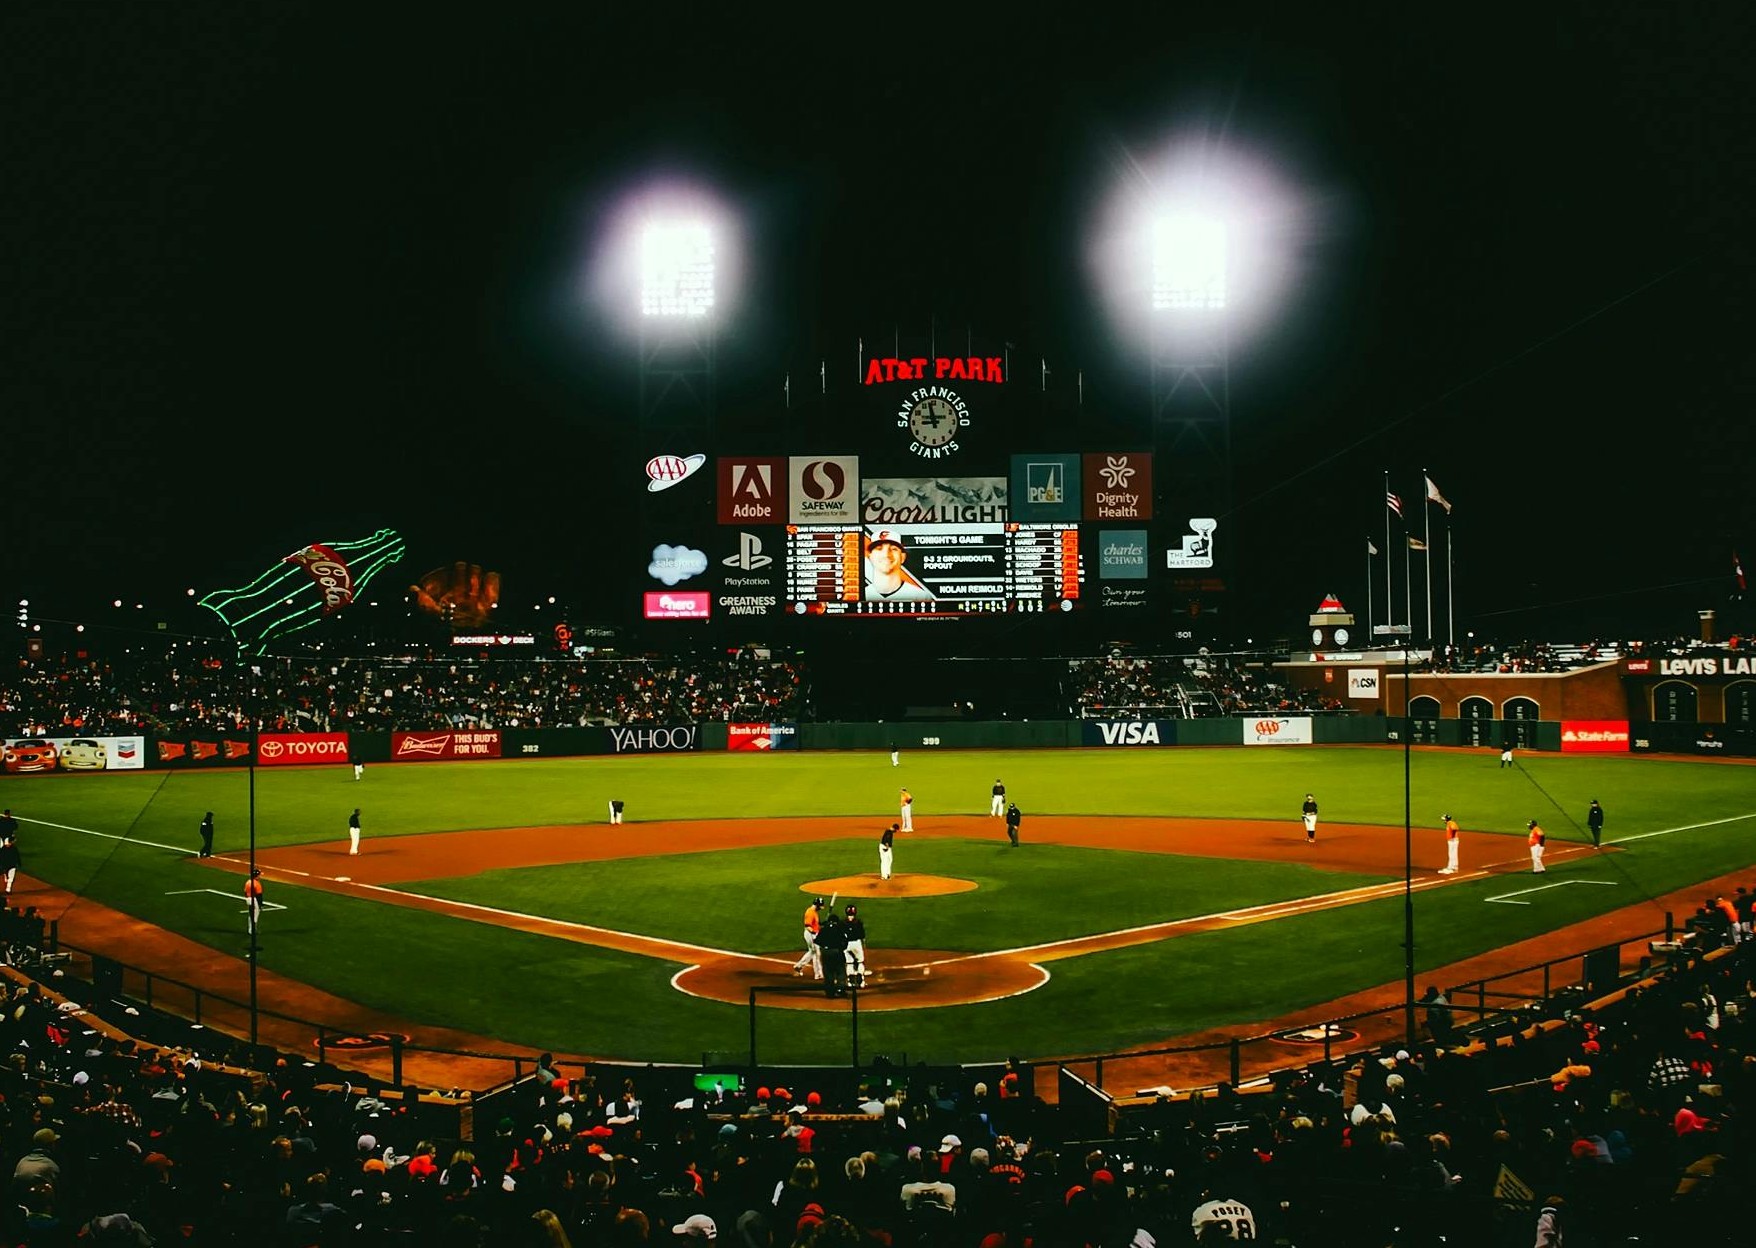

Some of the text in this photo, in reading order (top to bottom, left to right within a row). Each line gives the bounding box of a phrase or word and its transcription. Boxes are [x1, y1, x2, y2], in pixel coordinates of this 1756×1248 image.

[865, 357, 1004, 385] AT&T PARK
[897, 386, 970, 428] SAN FRANCISCO
[910, 440, 958, 458] GIANTS
[1096, 492, 1138, 506] Dignity
[732, 504, 772, 517] Adobe
[802, 502, 844, 510] SAFEWAY
[864, 496, 1008, 522] Coors LIGHT
[1098, 507, 1138, 517] Health
[914, 536, 957, 544] TONIGHT'S
[1104, 544, 1143, 556] charles
[1104, 556, 1143, 565] SCHWAB
[725, 578, 770, 587] PlayStation
[1102, 586, 1146, 599] Own your
[719, 597, 776, 606] GREATNESS
[729, 606, 766, 615] AWAITS
[1177, 631, 1192, 639] 501
[1360, 678, 1376, 688] CSN
[730, 726, 795, 735] Bank of America
[1096, 722, 1160, 744] VISA
[454, 734, 497, 743] THIS BUD'S
[609, 726, 696, 752] YAHOO!
[923, 737, 940, 745] 399
[1577, 731, 1628, 741] State Farm
[286, 741, 347, 754] TOYOTA
[454, 744, 490, 754] FOR YOU.
[1212, 1206, 1245, 1218] POSEY
